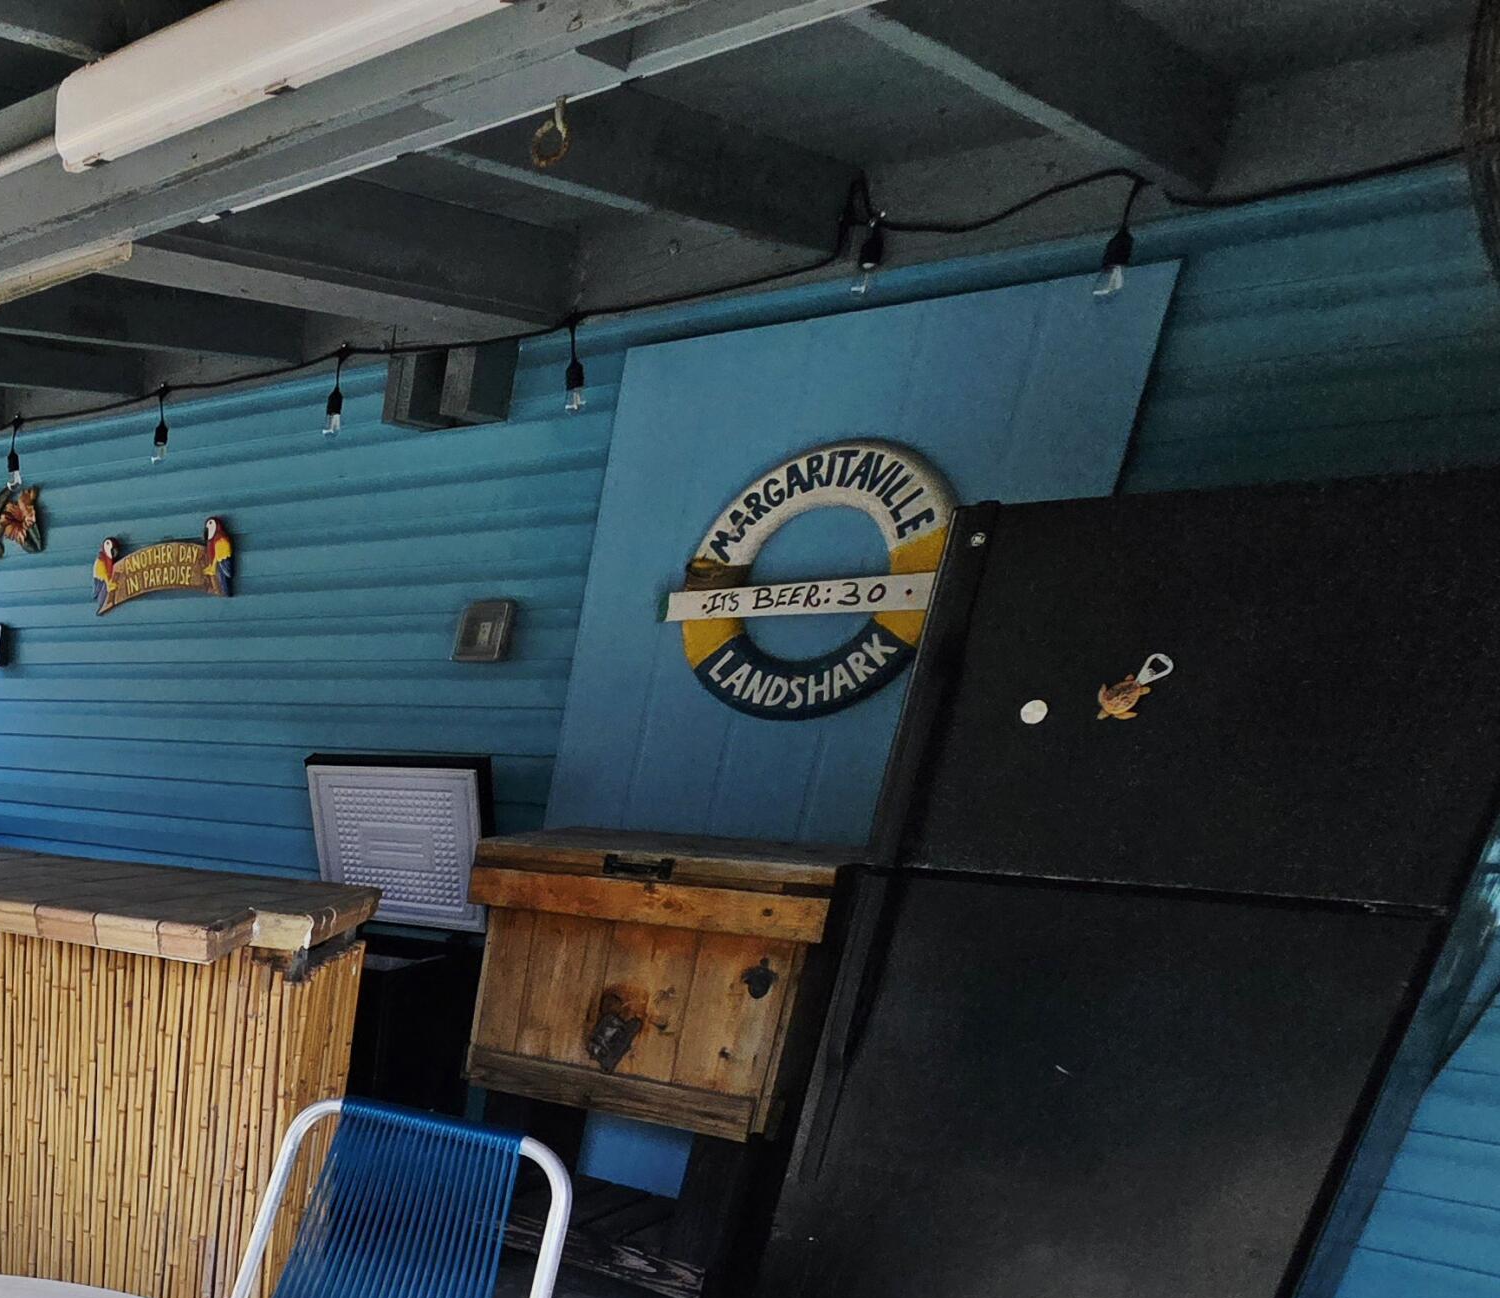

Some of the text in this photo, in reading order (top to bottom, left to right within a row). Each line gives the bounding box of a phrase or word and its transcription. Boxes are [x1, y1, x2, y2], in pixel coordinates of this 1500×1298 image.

[709, 449, 936, 563] MARGARITAVILLE
[125, 545, 198, 575] ANOTHER DAY
[126, 566, 191, 595] IN PARADISE
[708, 633, 898, 709] LANDSHARK
